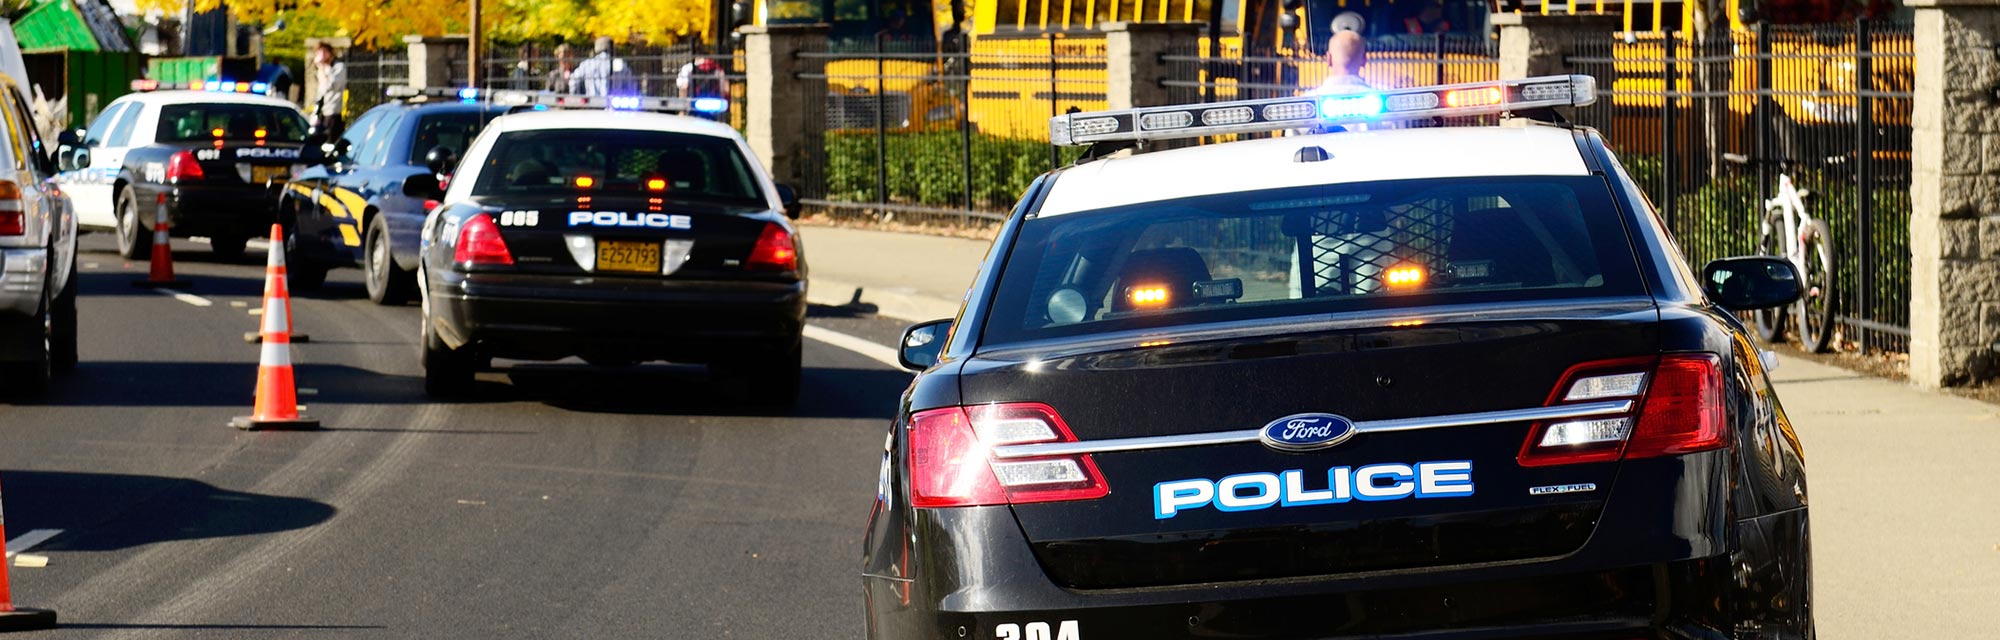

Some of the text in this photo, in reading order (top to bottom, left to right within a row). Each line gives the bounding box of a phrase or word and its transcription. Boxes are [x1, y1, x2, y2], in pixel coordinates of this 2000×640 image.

[568, 211, 692, 230] POLICE
[1282, 418, 1333, 440] Ford
[1153, 459, 1475, 520] POLICE
[1533, 483, 1595, 494] FLEX FUEL
